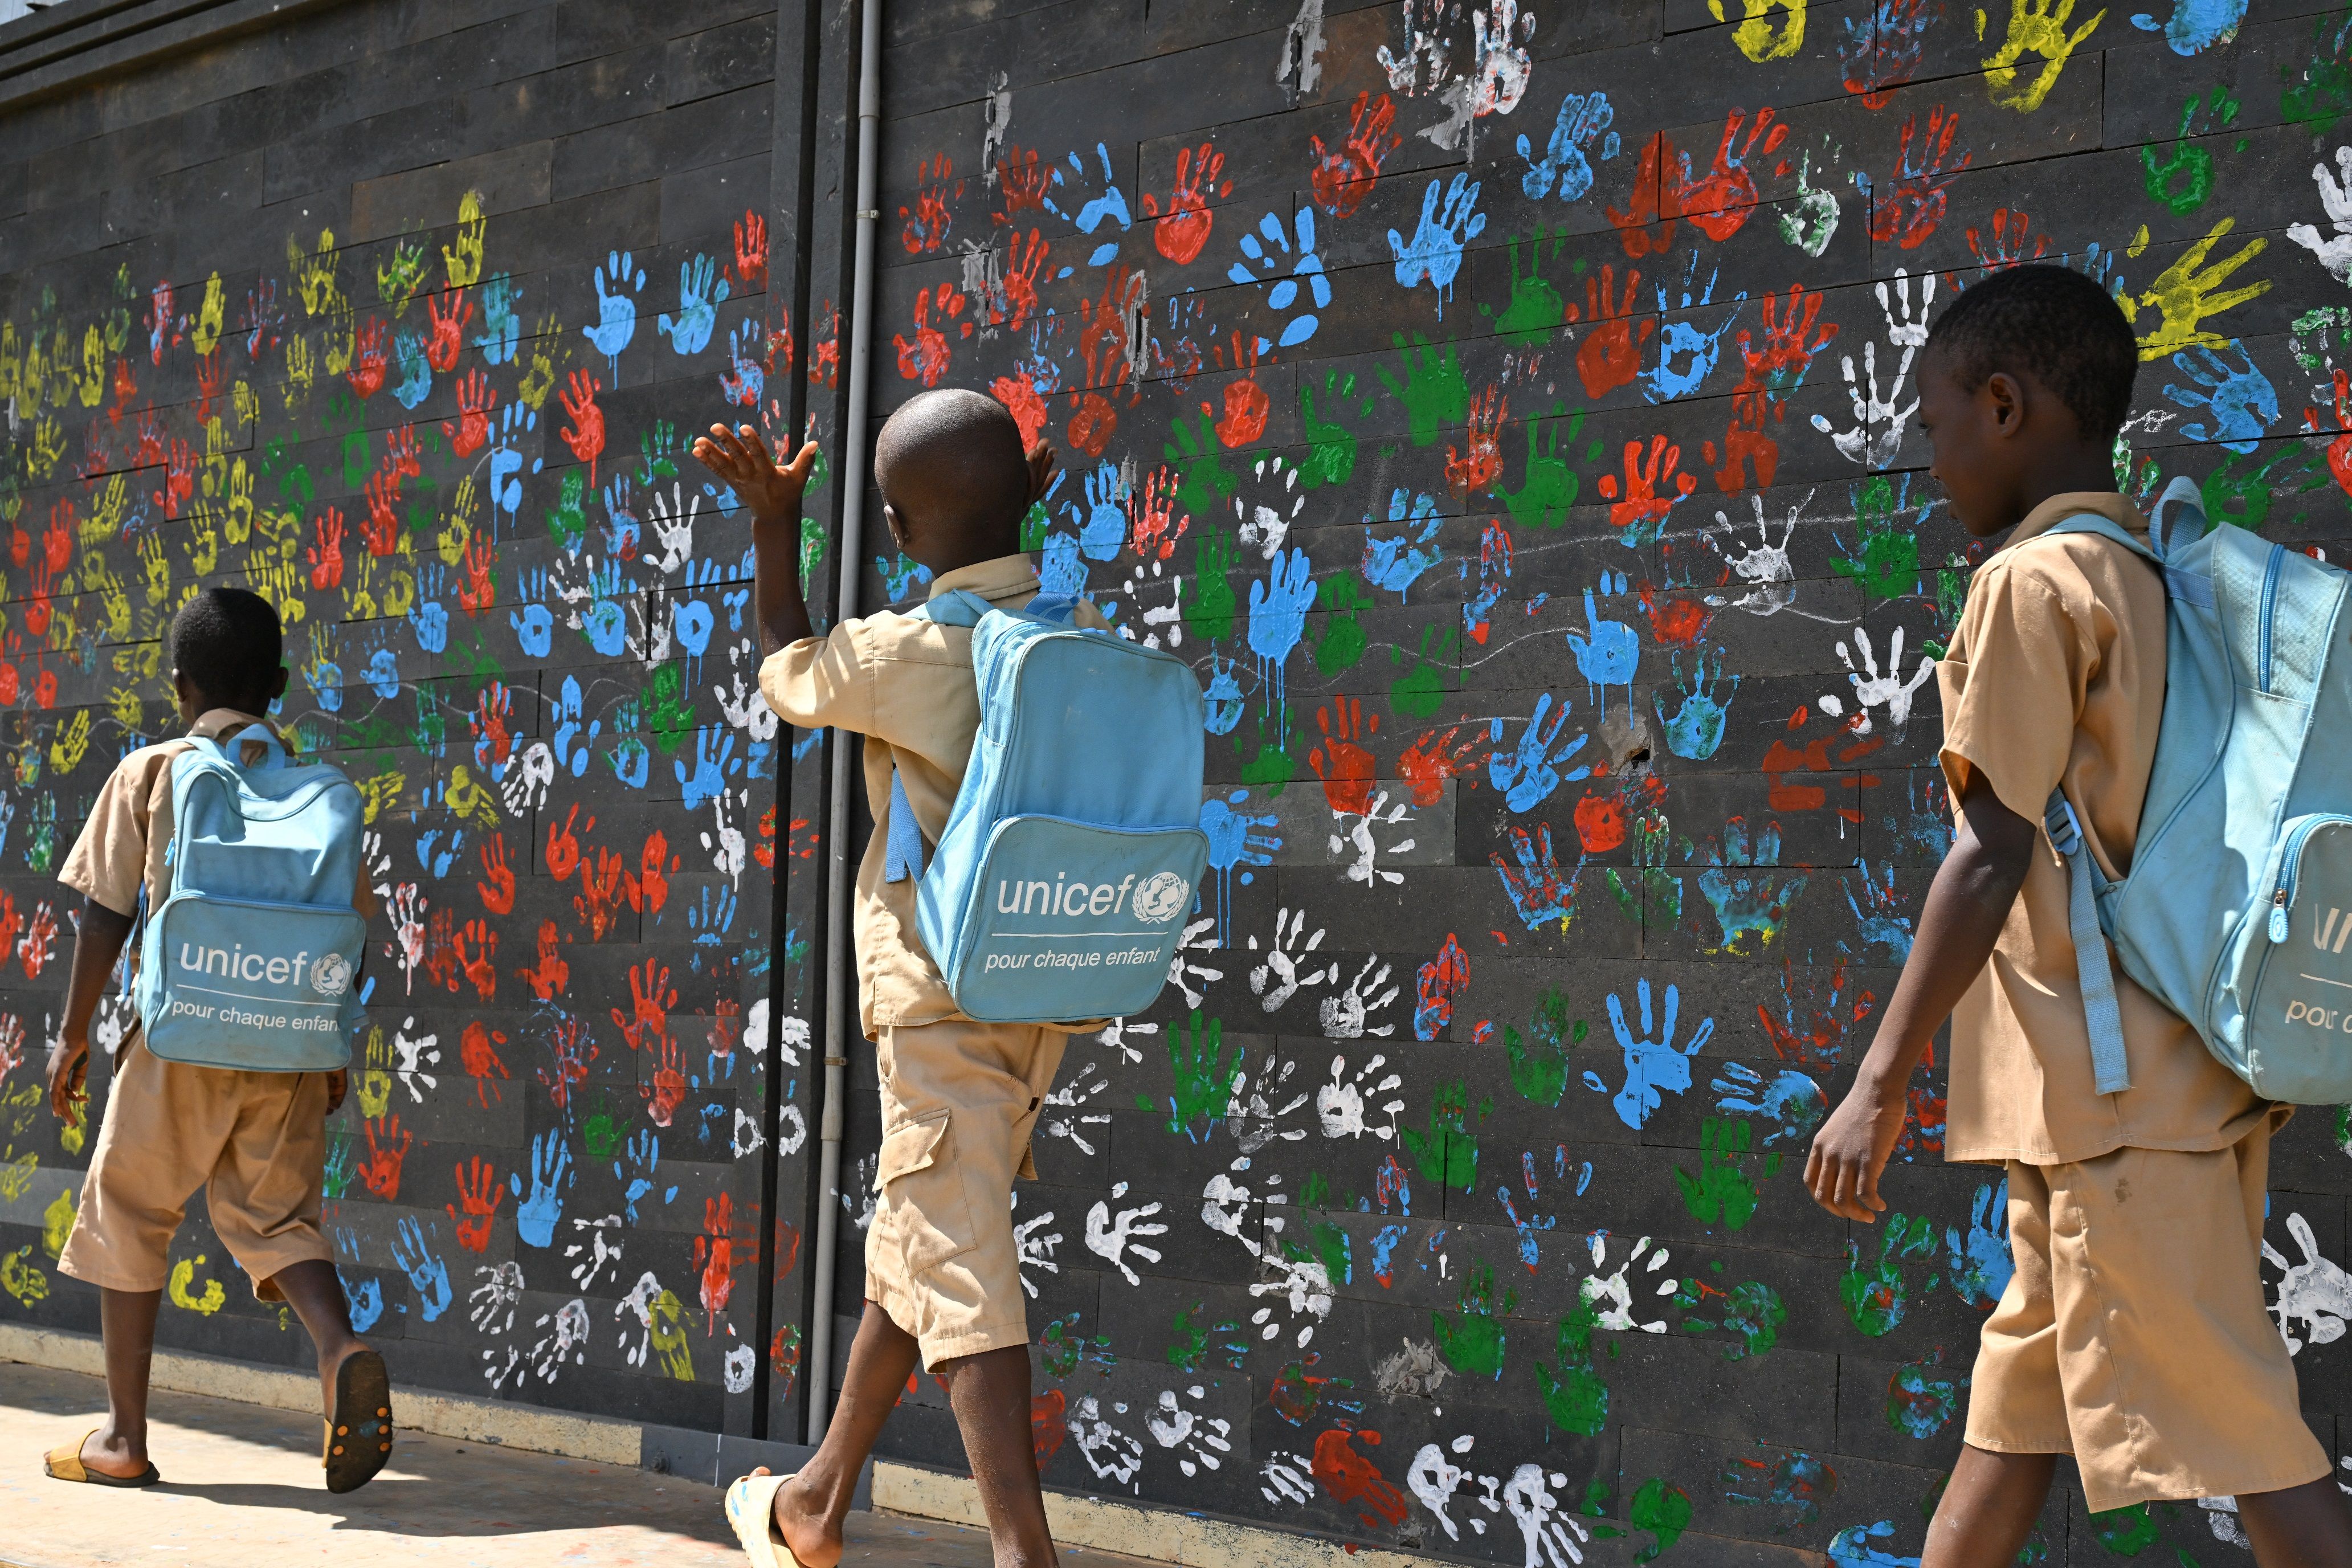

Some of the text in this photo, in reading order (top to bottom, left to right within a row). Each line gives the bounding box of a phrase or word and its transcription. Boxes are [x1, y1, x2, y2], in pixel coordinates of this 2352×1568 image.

[998, 871, 1135, 916] unicef
[180, 943, 307, 985] unicef
[985, 946, 1161, 973] pour chaque enfant
[172, 1001, 340, 1031] pour chaque enfan
